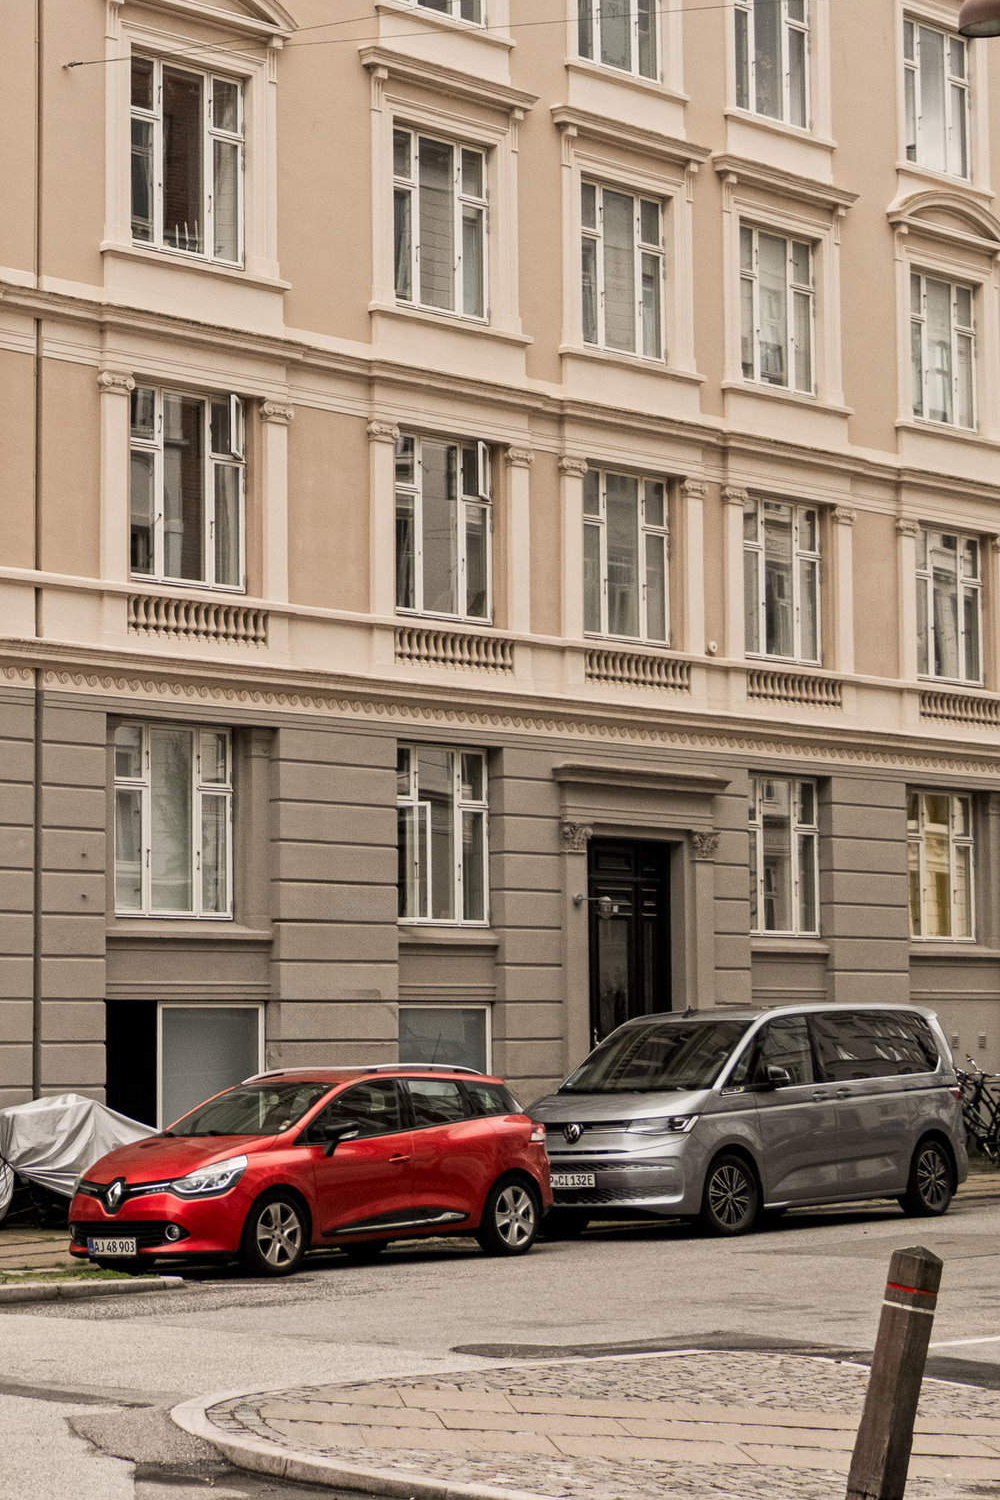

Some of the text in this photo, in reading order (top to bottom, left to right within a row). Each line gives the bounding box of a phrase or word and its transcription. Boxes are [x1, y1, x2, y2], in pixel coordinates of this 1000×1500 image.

[94, 1241, 135, 1253] AJ 48 903
